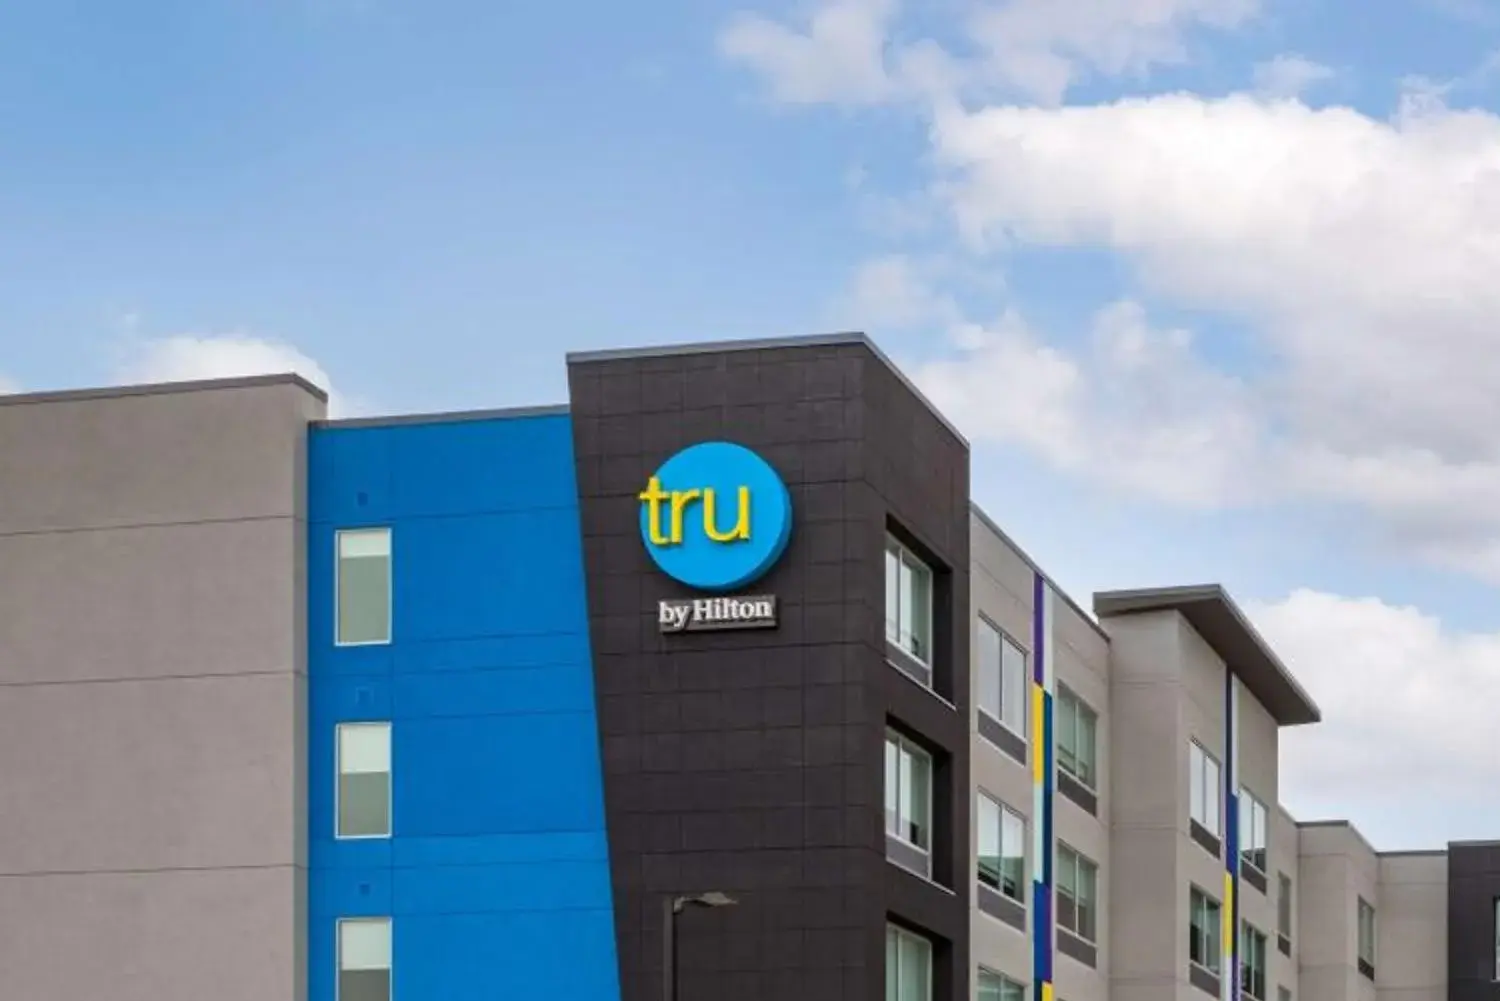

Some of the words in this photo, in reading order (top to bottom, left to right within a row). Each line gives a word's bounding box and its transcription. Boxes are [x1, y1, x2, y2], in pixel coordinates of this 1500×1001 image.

[639, 476, 750, 544] tru
[658, 602, 689, 628] by
[693, 599, 772, 620] Hilton
